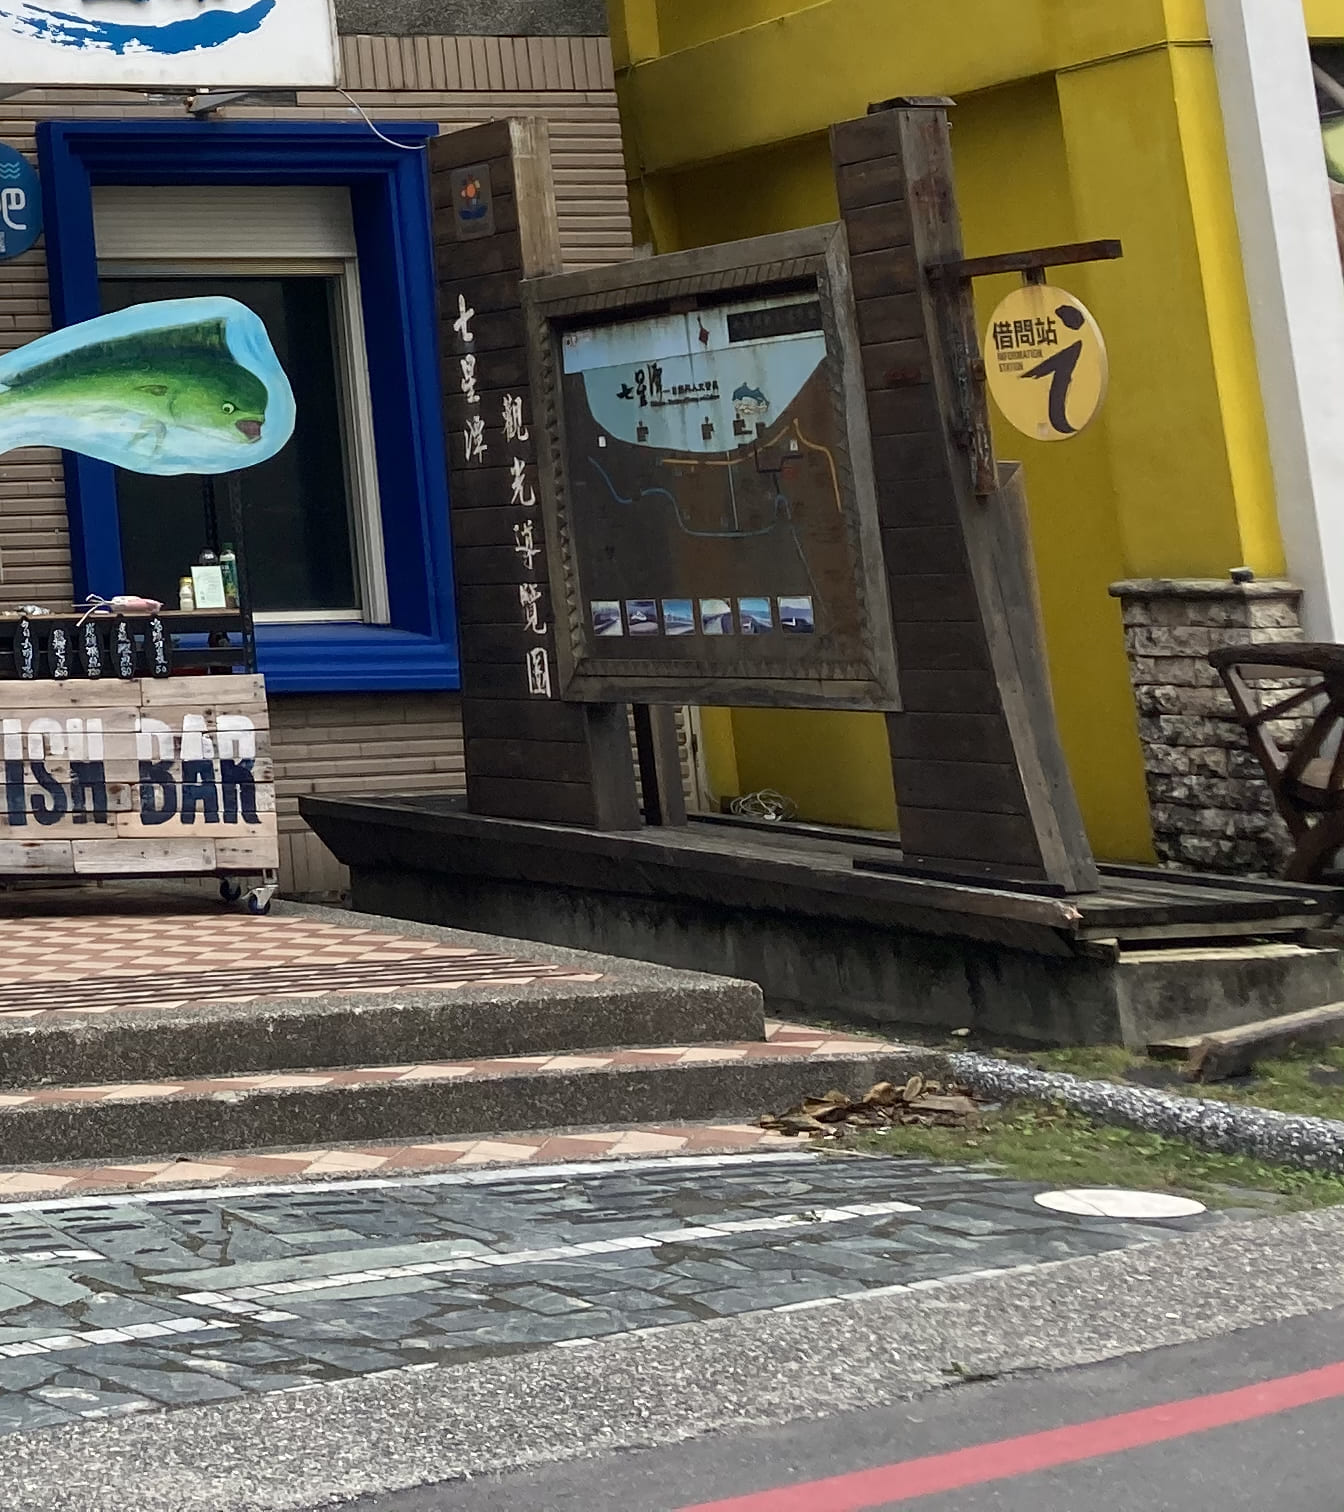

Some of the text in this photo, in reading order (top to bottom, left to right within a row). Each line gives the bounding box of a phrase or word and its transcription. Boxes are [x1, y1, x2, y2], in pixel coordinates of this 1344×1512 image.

[453, 292, 488, 464] 七星潭
[993, 316, 1058, 350] 借問站
[501, 392, 552, 699] 觀光導覽圖
[135, 714, 262, 826] BAR
